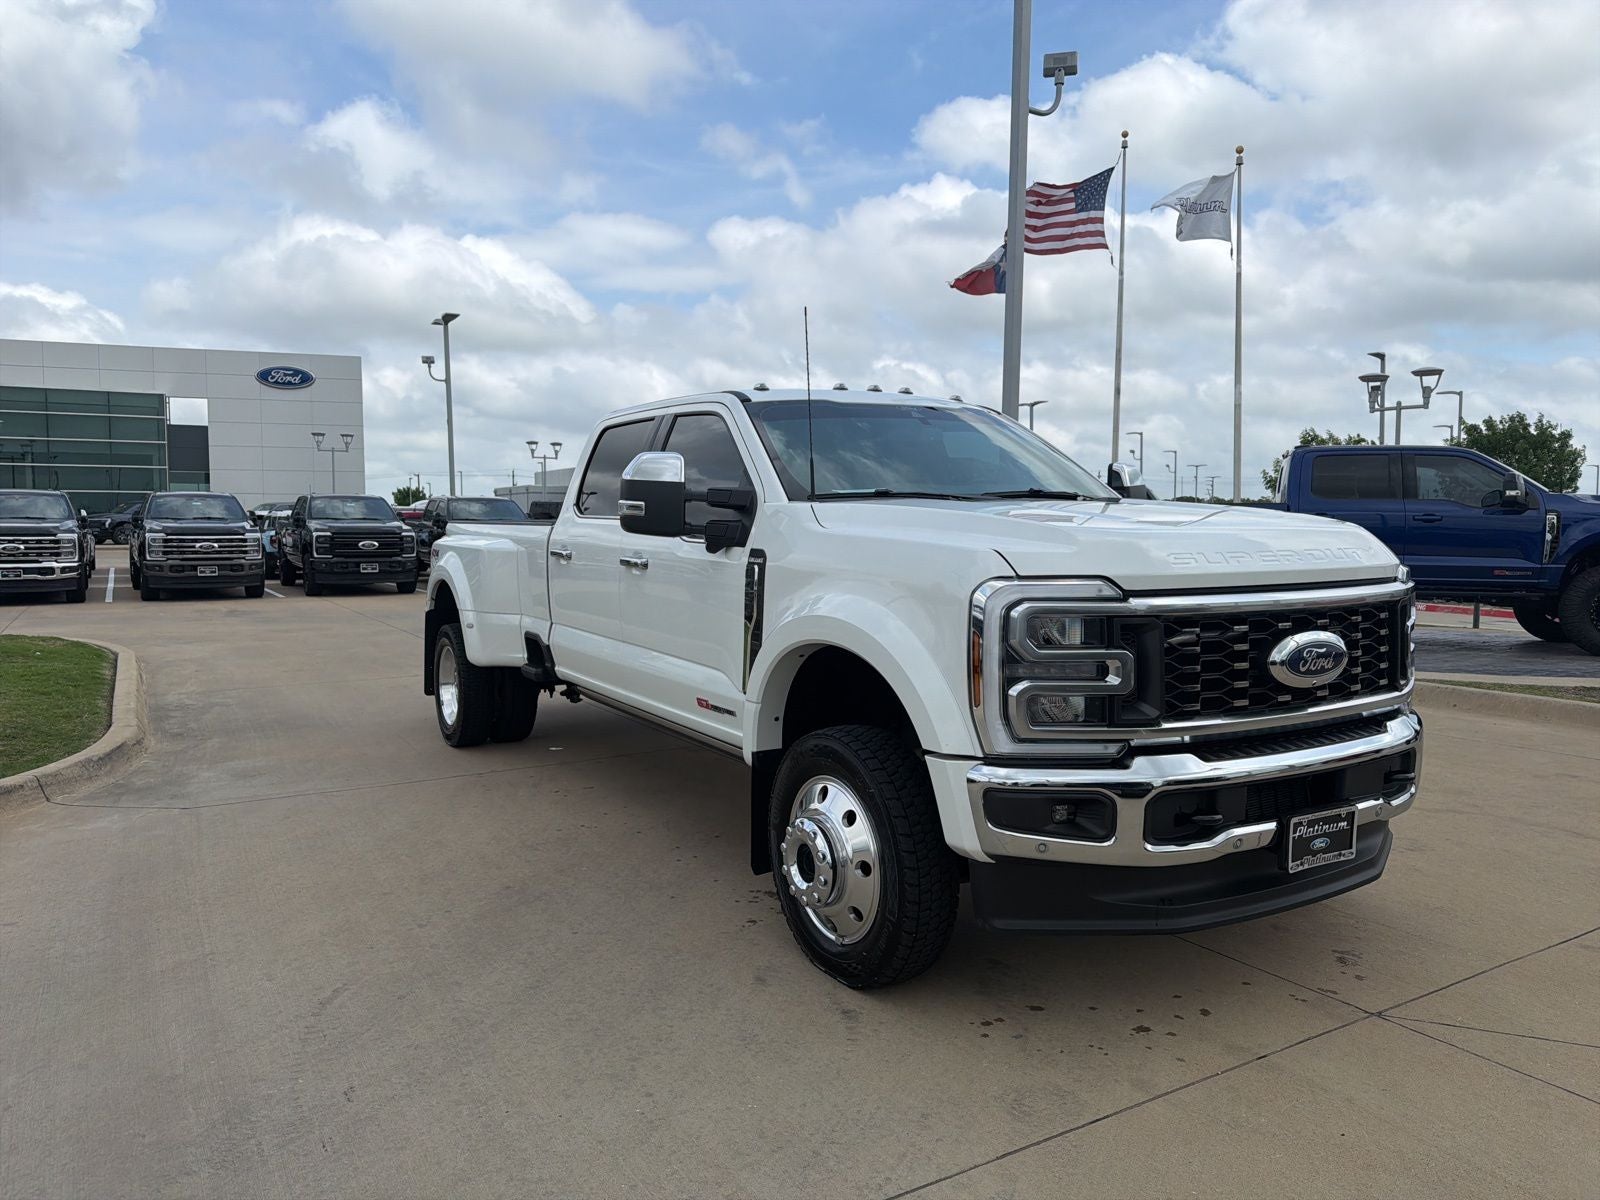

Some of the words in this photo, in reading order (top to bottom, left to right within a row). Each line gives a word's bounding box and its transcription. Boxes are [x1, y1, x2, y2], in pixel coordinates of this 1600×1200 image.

[268, 369, 302, 384] Ford
[1166, 549, 1303, 566] SUPER
[1303, 546, 1371, 562] DUT
[1299, 647, 1336, 672] Ford
[1291, 821, 1351, 839] Platinum
[1302, 853, 1340, 868] Platinum
